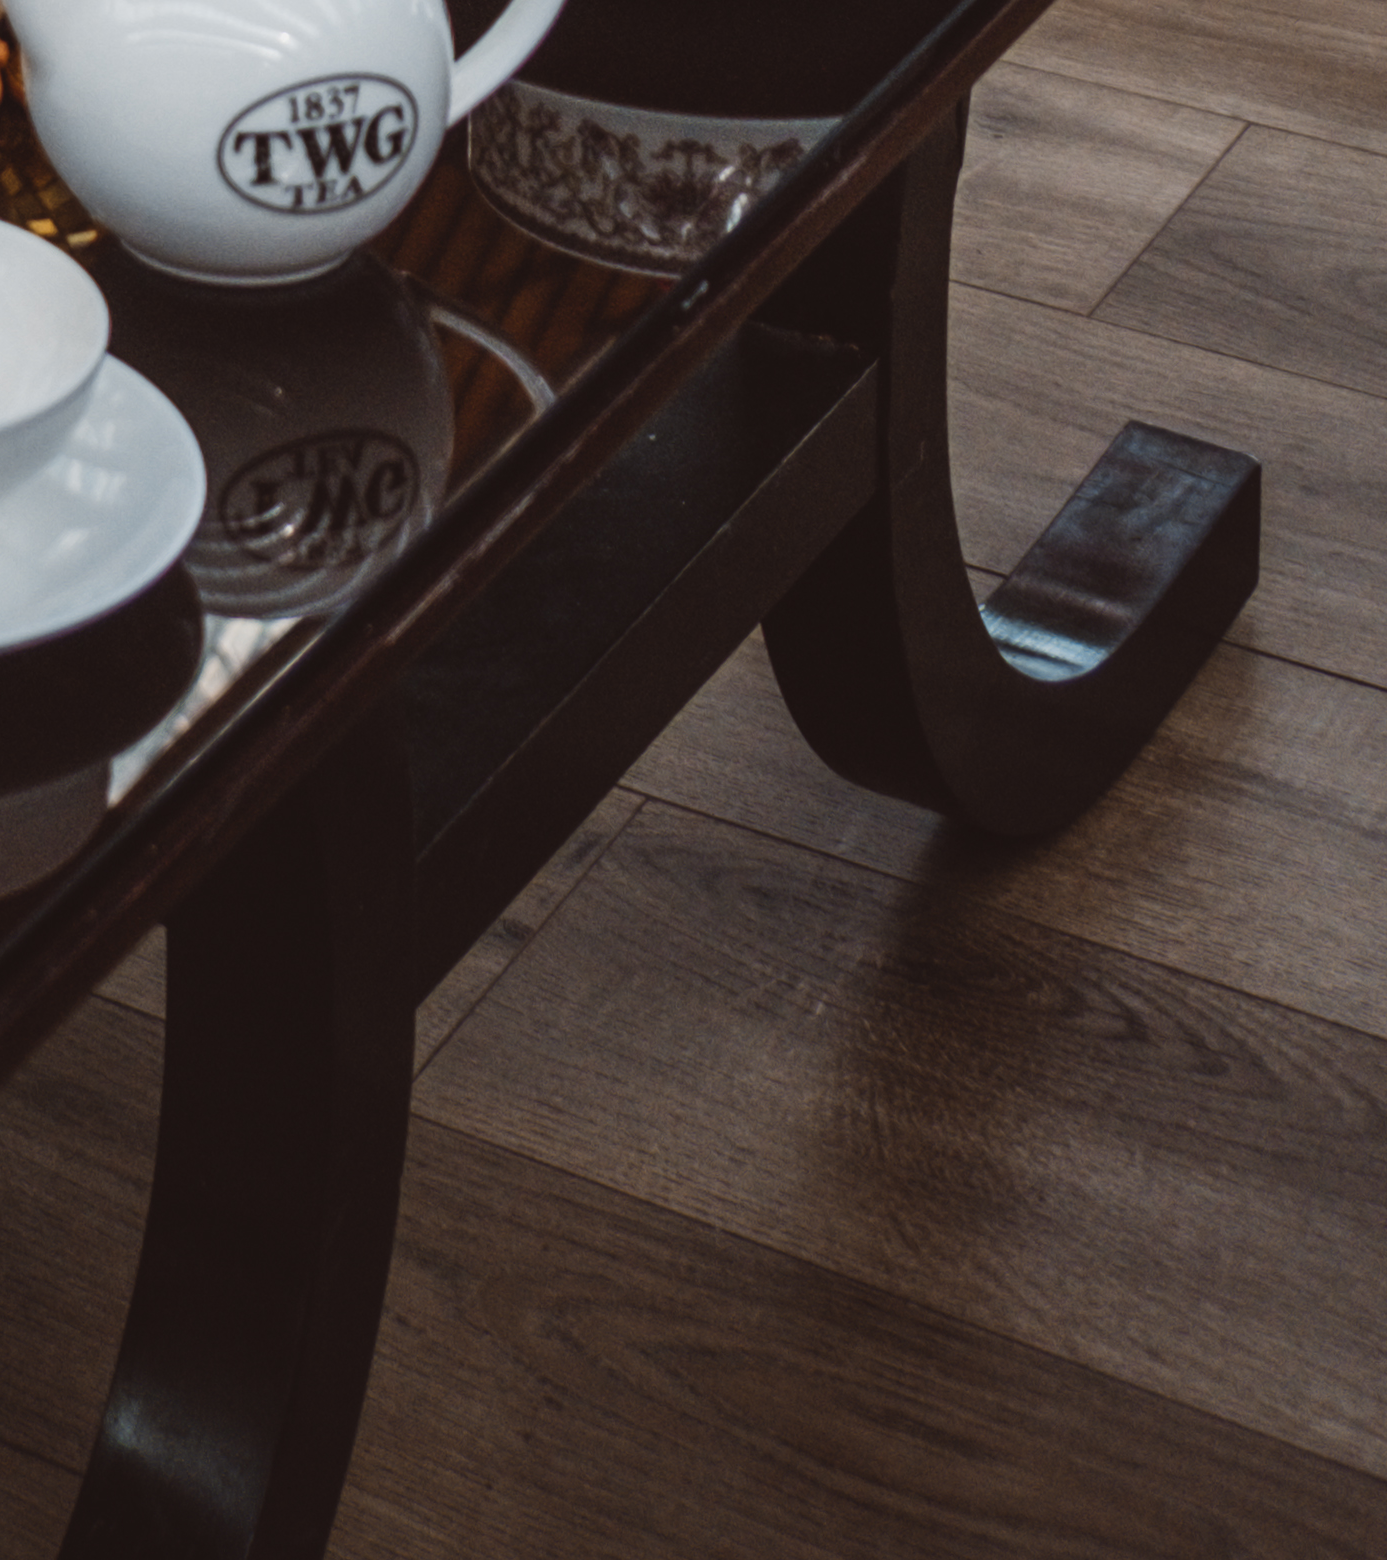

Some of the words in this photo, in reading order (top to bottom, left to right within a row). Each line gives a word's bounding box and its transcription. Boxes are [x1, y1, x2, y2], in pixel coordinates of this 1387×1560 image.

[288, 83, 360, 124] 1837
[232, 104, 407, 186] TWG
[285, 175, 364, 209] TEA
